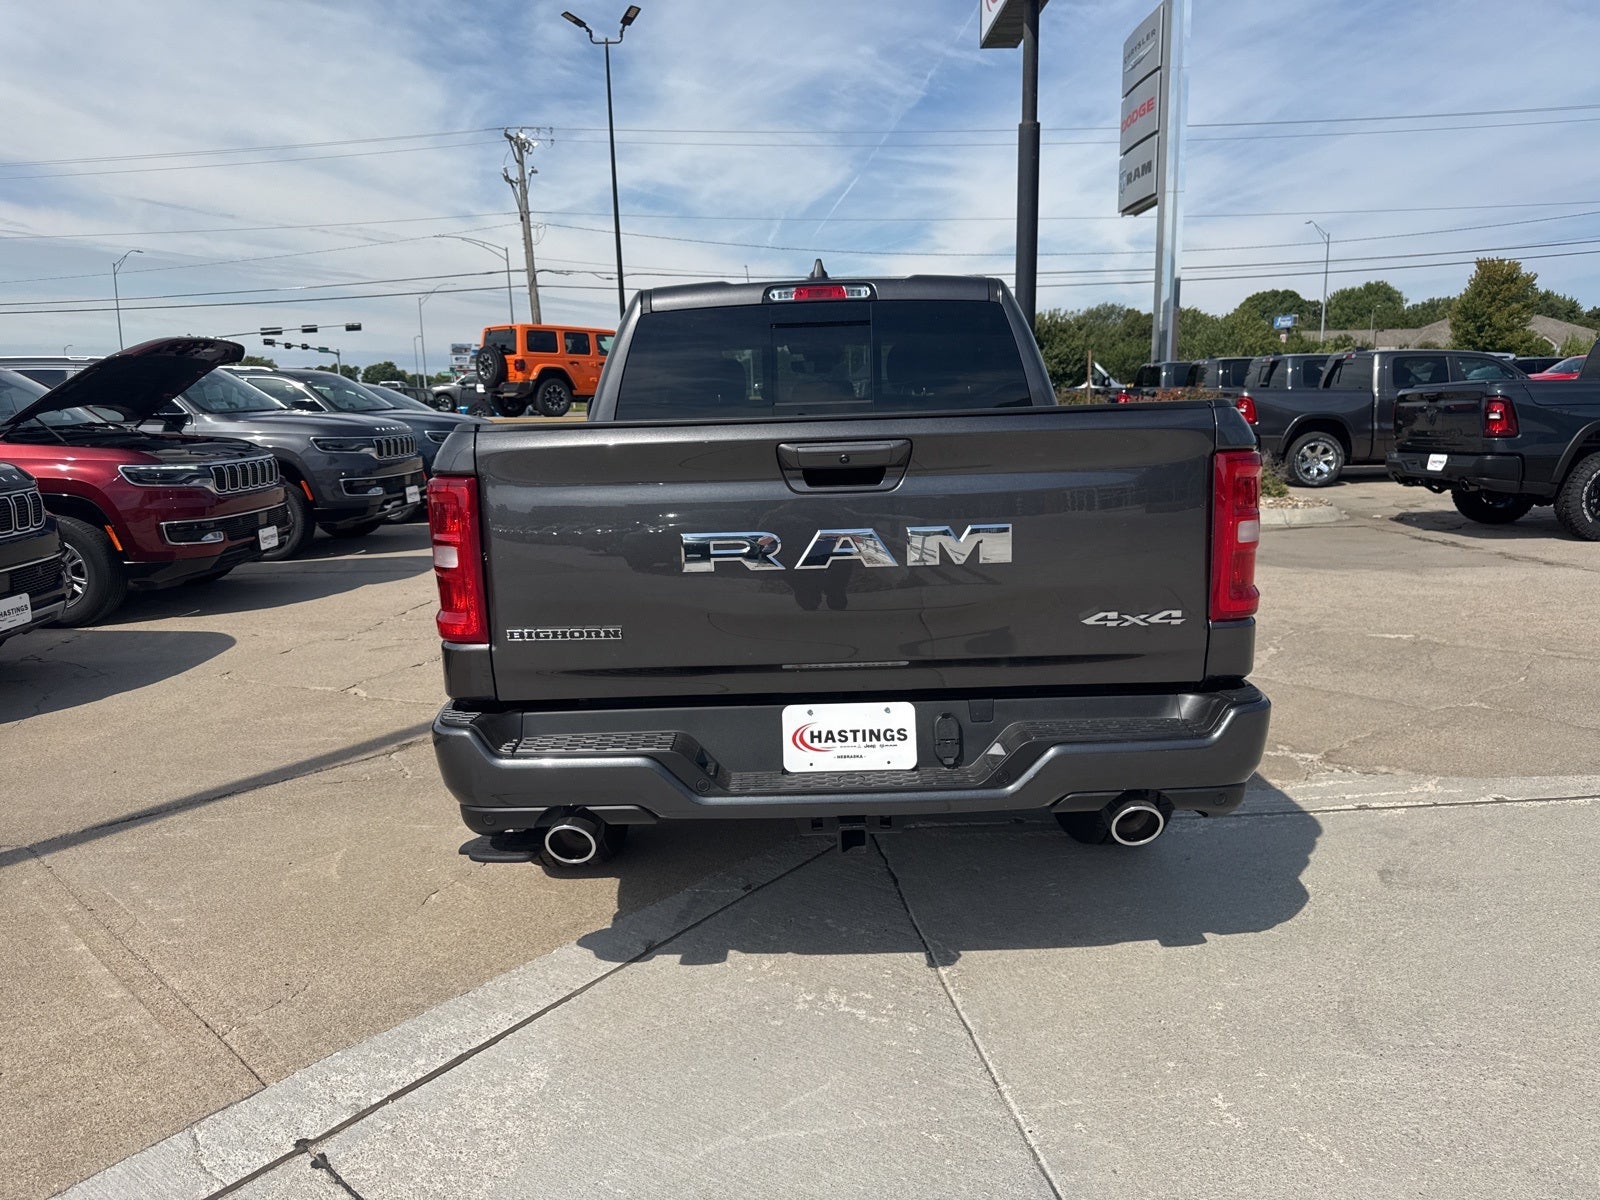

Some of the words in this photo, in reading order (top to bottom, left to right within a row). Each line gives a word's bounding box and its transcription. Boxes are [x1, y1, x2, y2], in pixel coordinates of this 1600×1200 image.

[1124, 28, 1156, 64] CHRYSLER
[1121, 96, 1155, 133] DODGE
[1126, 160, 1152, 186] RAM
[680, 523, 1012, 573] RAM
[506, 627, 622, 641] BIGHORN
[809, 728, 908, 744] HASTINGS
